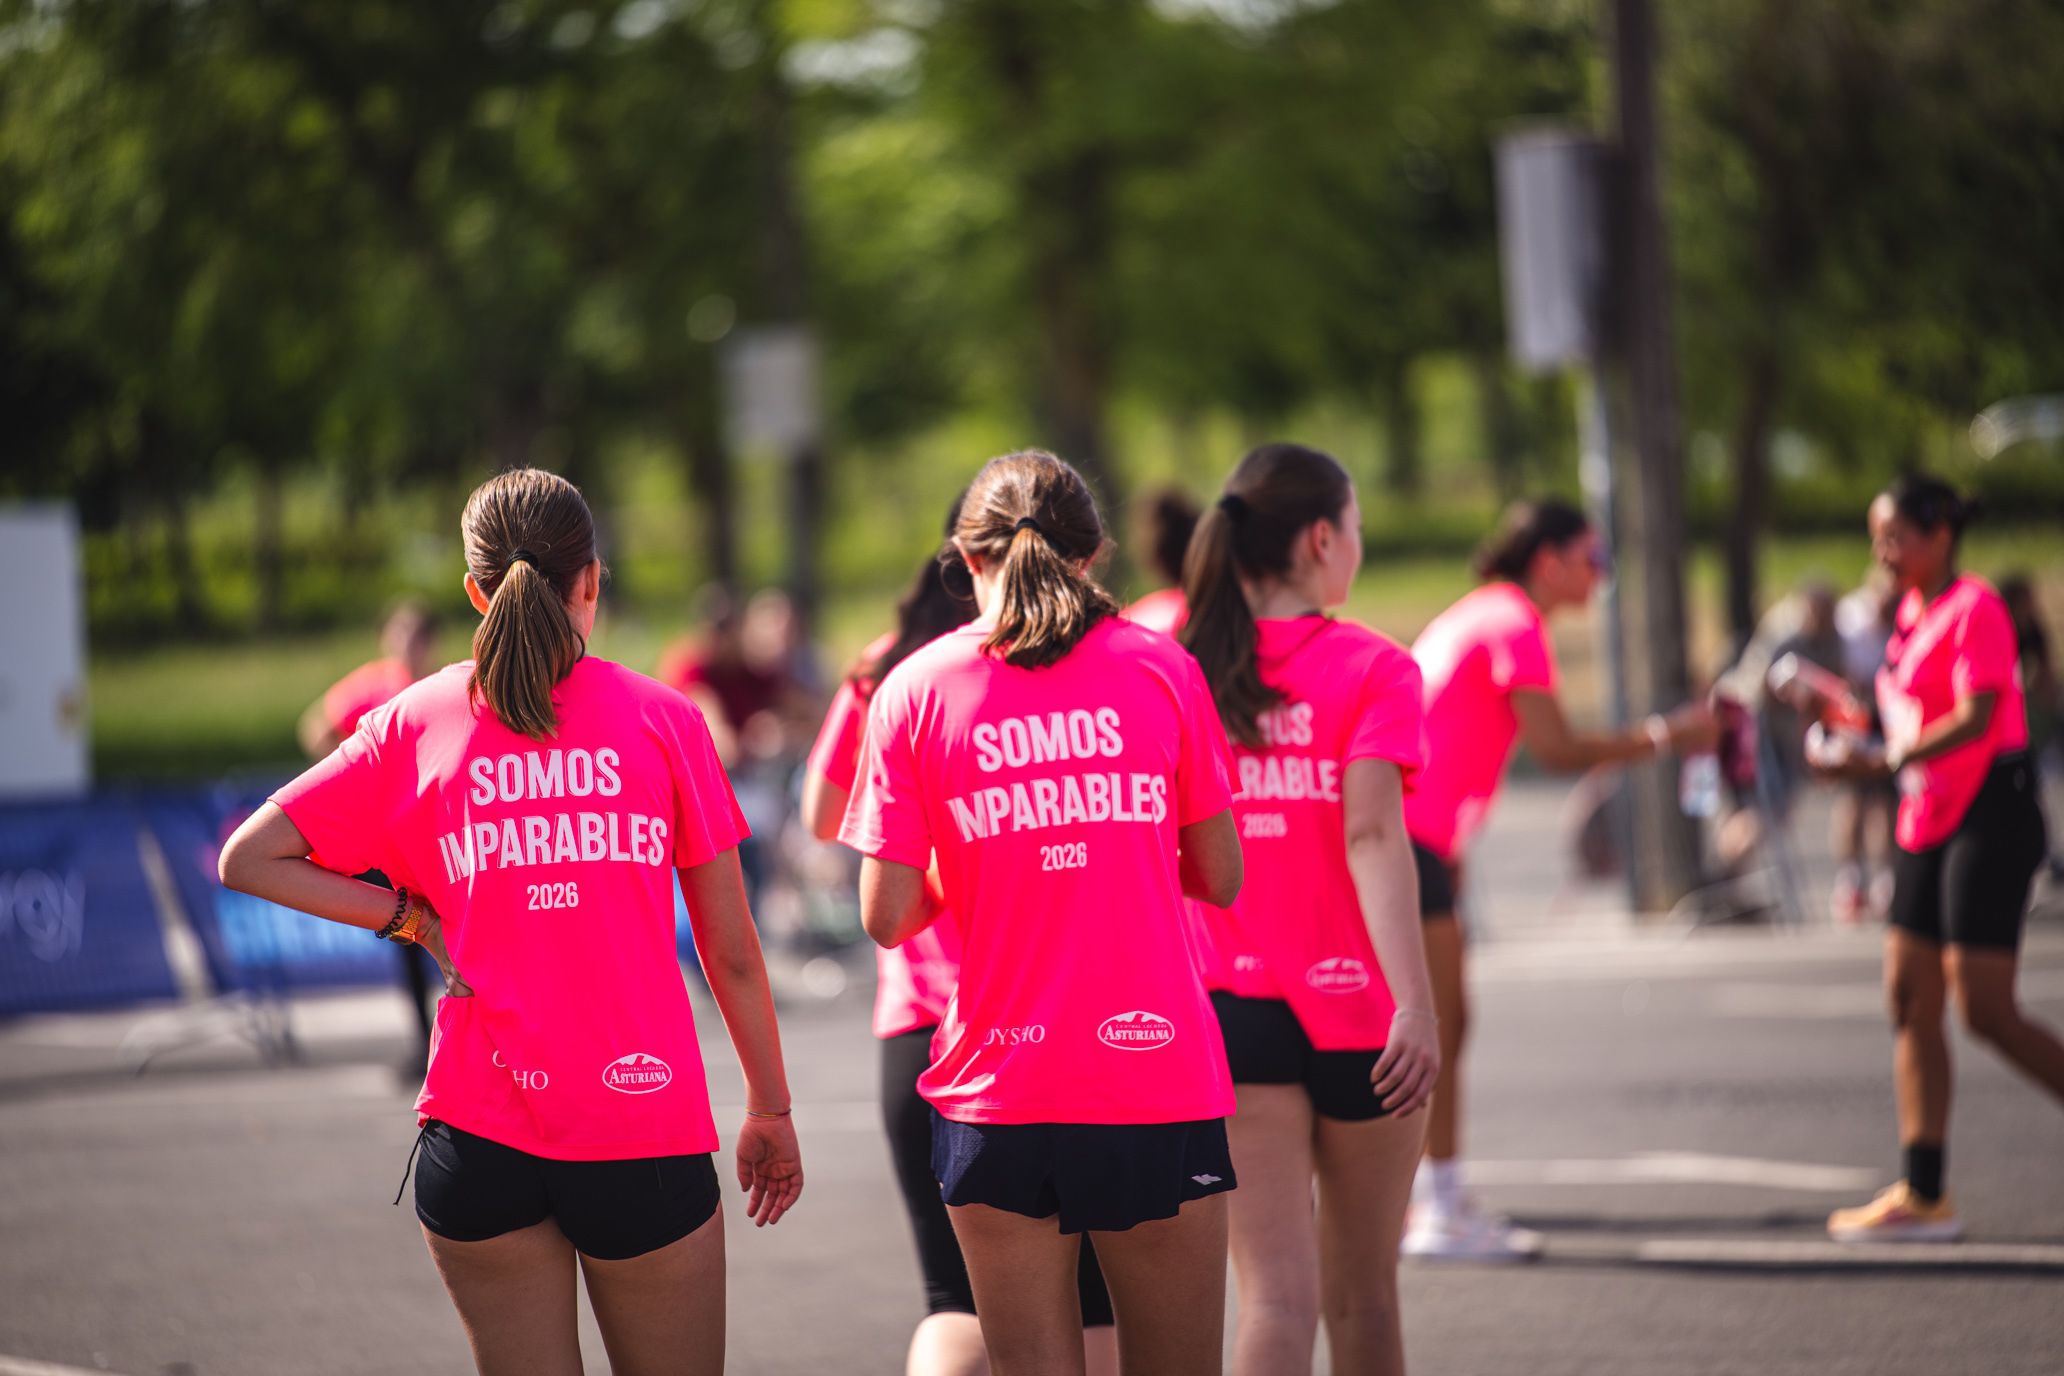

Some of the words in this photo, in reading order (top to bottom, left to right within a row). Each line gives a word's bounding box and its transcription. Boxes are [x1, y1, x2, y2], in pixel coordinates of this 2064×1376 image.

[972, 706, 1123, 773] SOMOS
[468, 747, 622, 806] SOMOS
[437, 811, 668, 885] IMPARABLES
[1039, 841, 1087, 872] 2026
[527, 881, 580, 911] 2026
[1103, 1025, 1170, 1041] ASTURIANA
[608, 1068, 668, 1085] ASTURIANA
